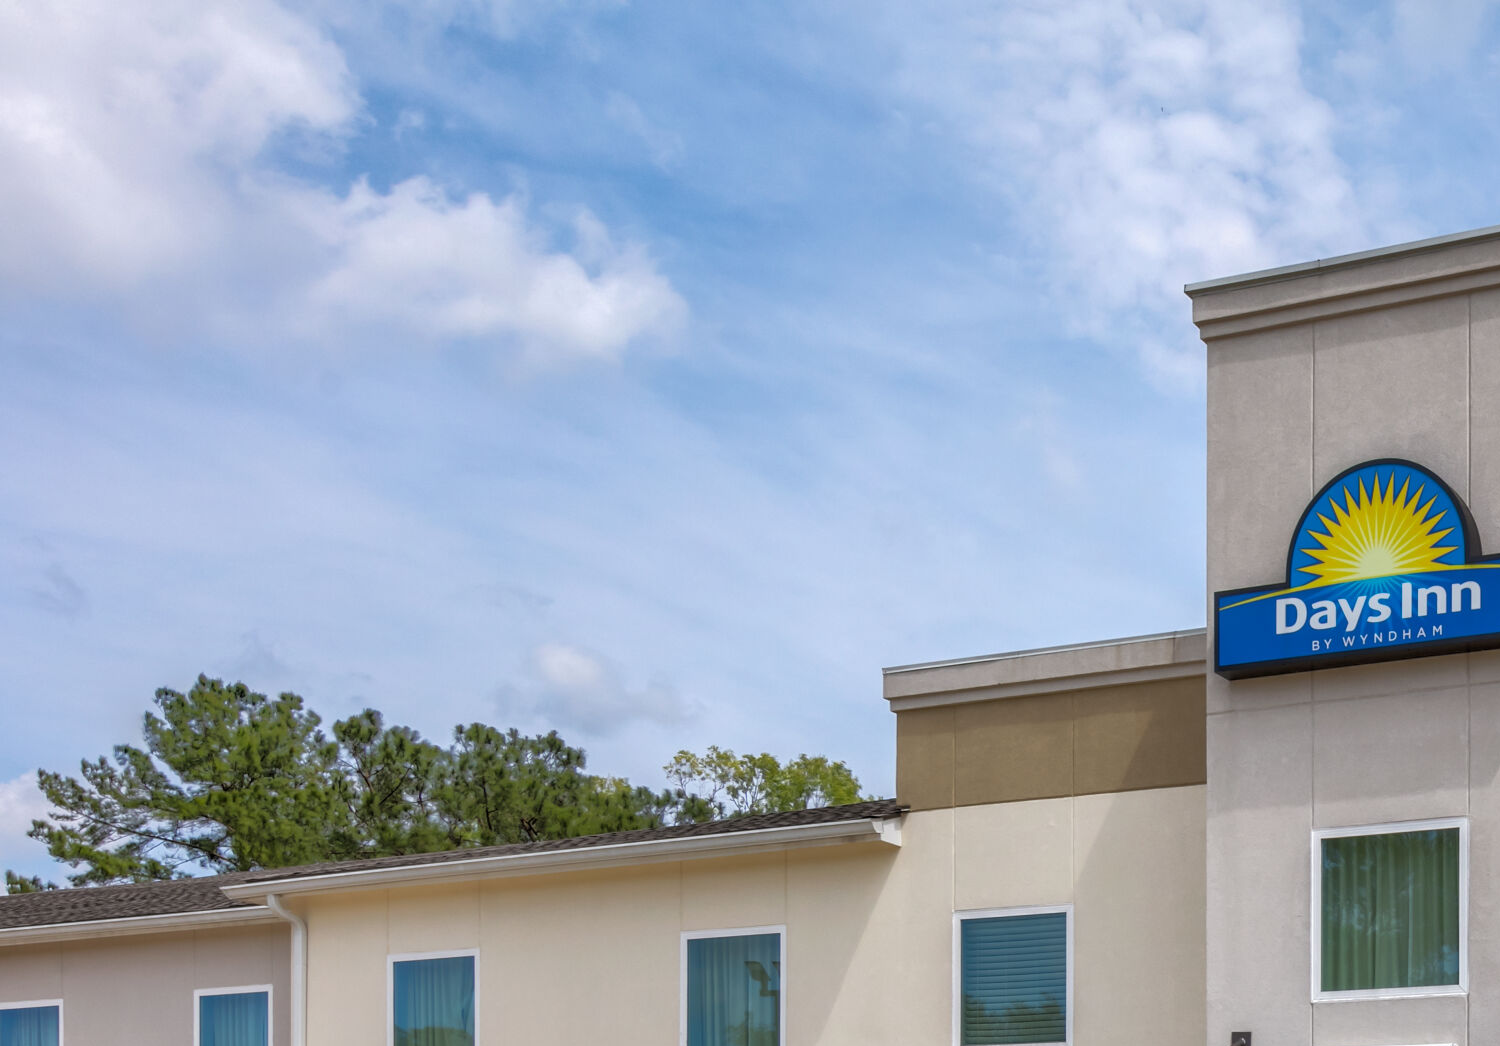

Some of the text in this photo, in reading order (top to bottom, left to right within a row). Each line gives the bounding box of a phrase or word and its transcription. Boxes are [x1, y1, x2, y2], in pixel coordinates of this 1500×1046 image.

[1275, 580, 1482, 635] Days Inn
[1311, 624, 1444, 652] BY WYNDHAM
